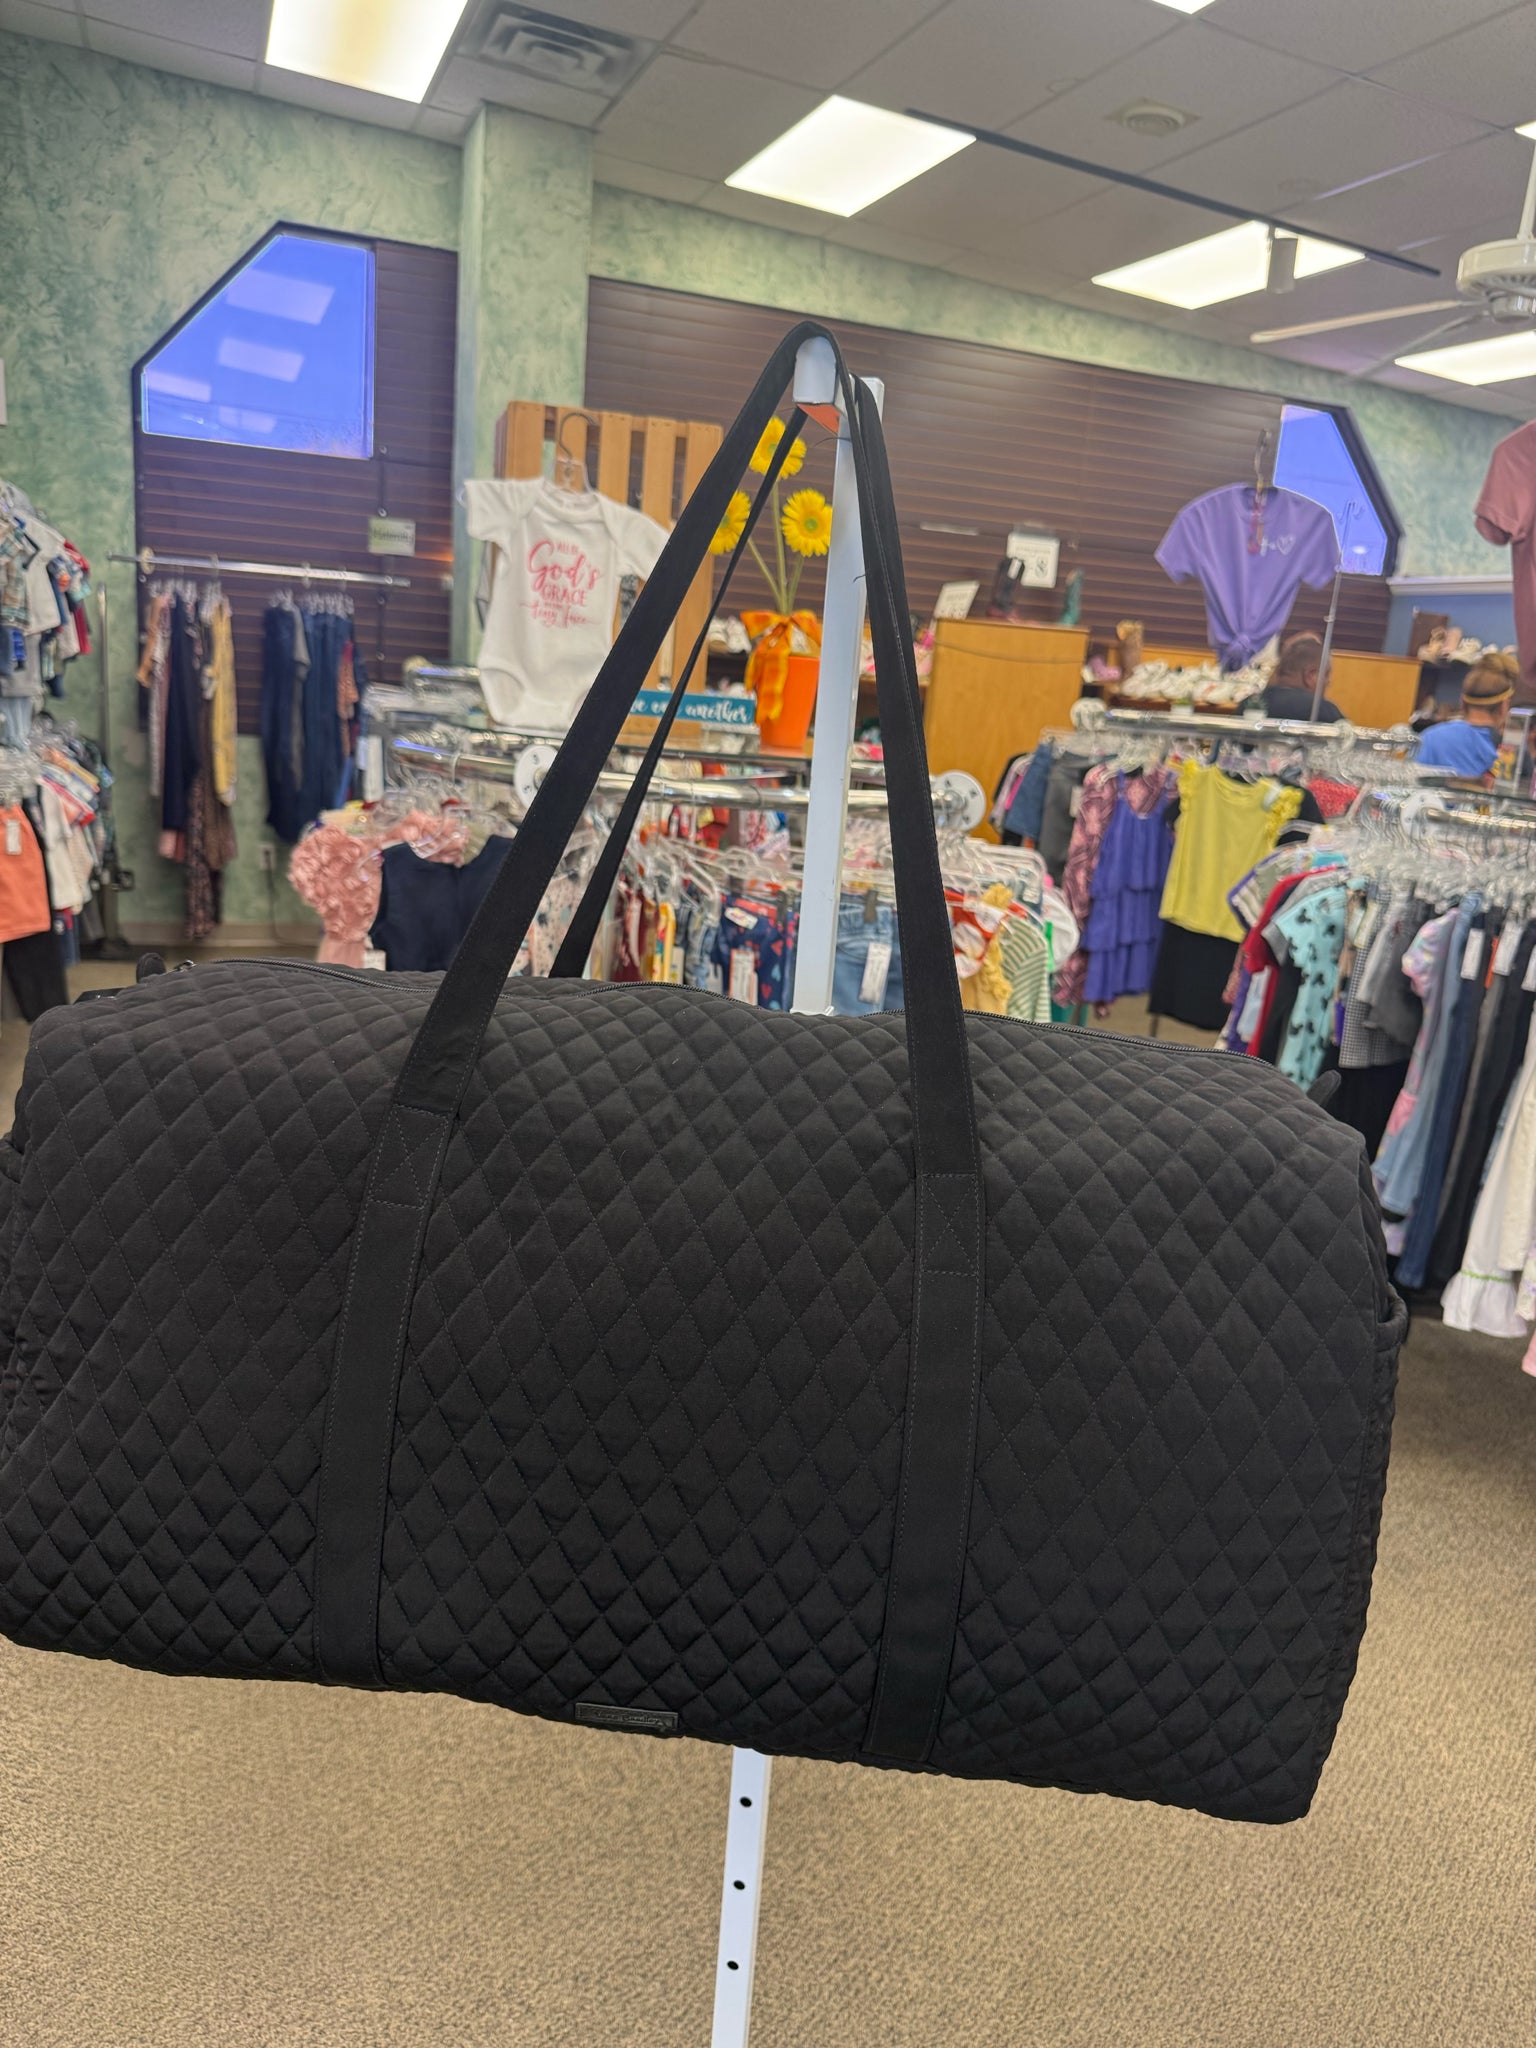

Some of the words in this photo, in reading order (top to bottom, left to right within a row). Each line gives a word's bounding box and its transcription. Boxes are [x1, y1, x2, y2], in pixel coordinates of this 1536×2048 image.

[527, 538, 603, 591] God's
[542, 583, 586, 607] GRACE
[685, 700, 748, 723] another
